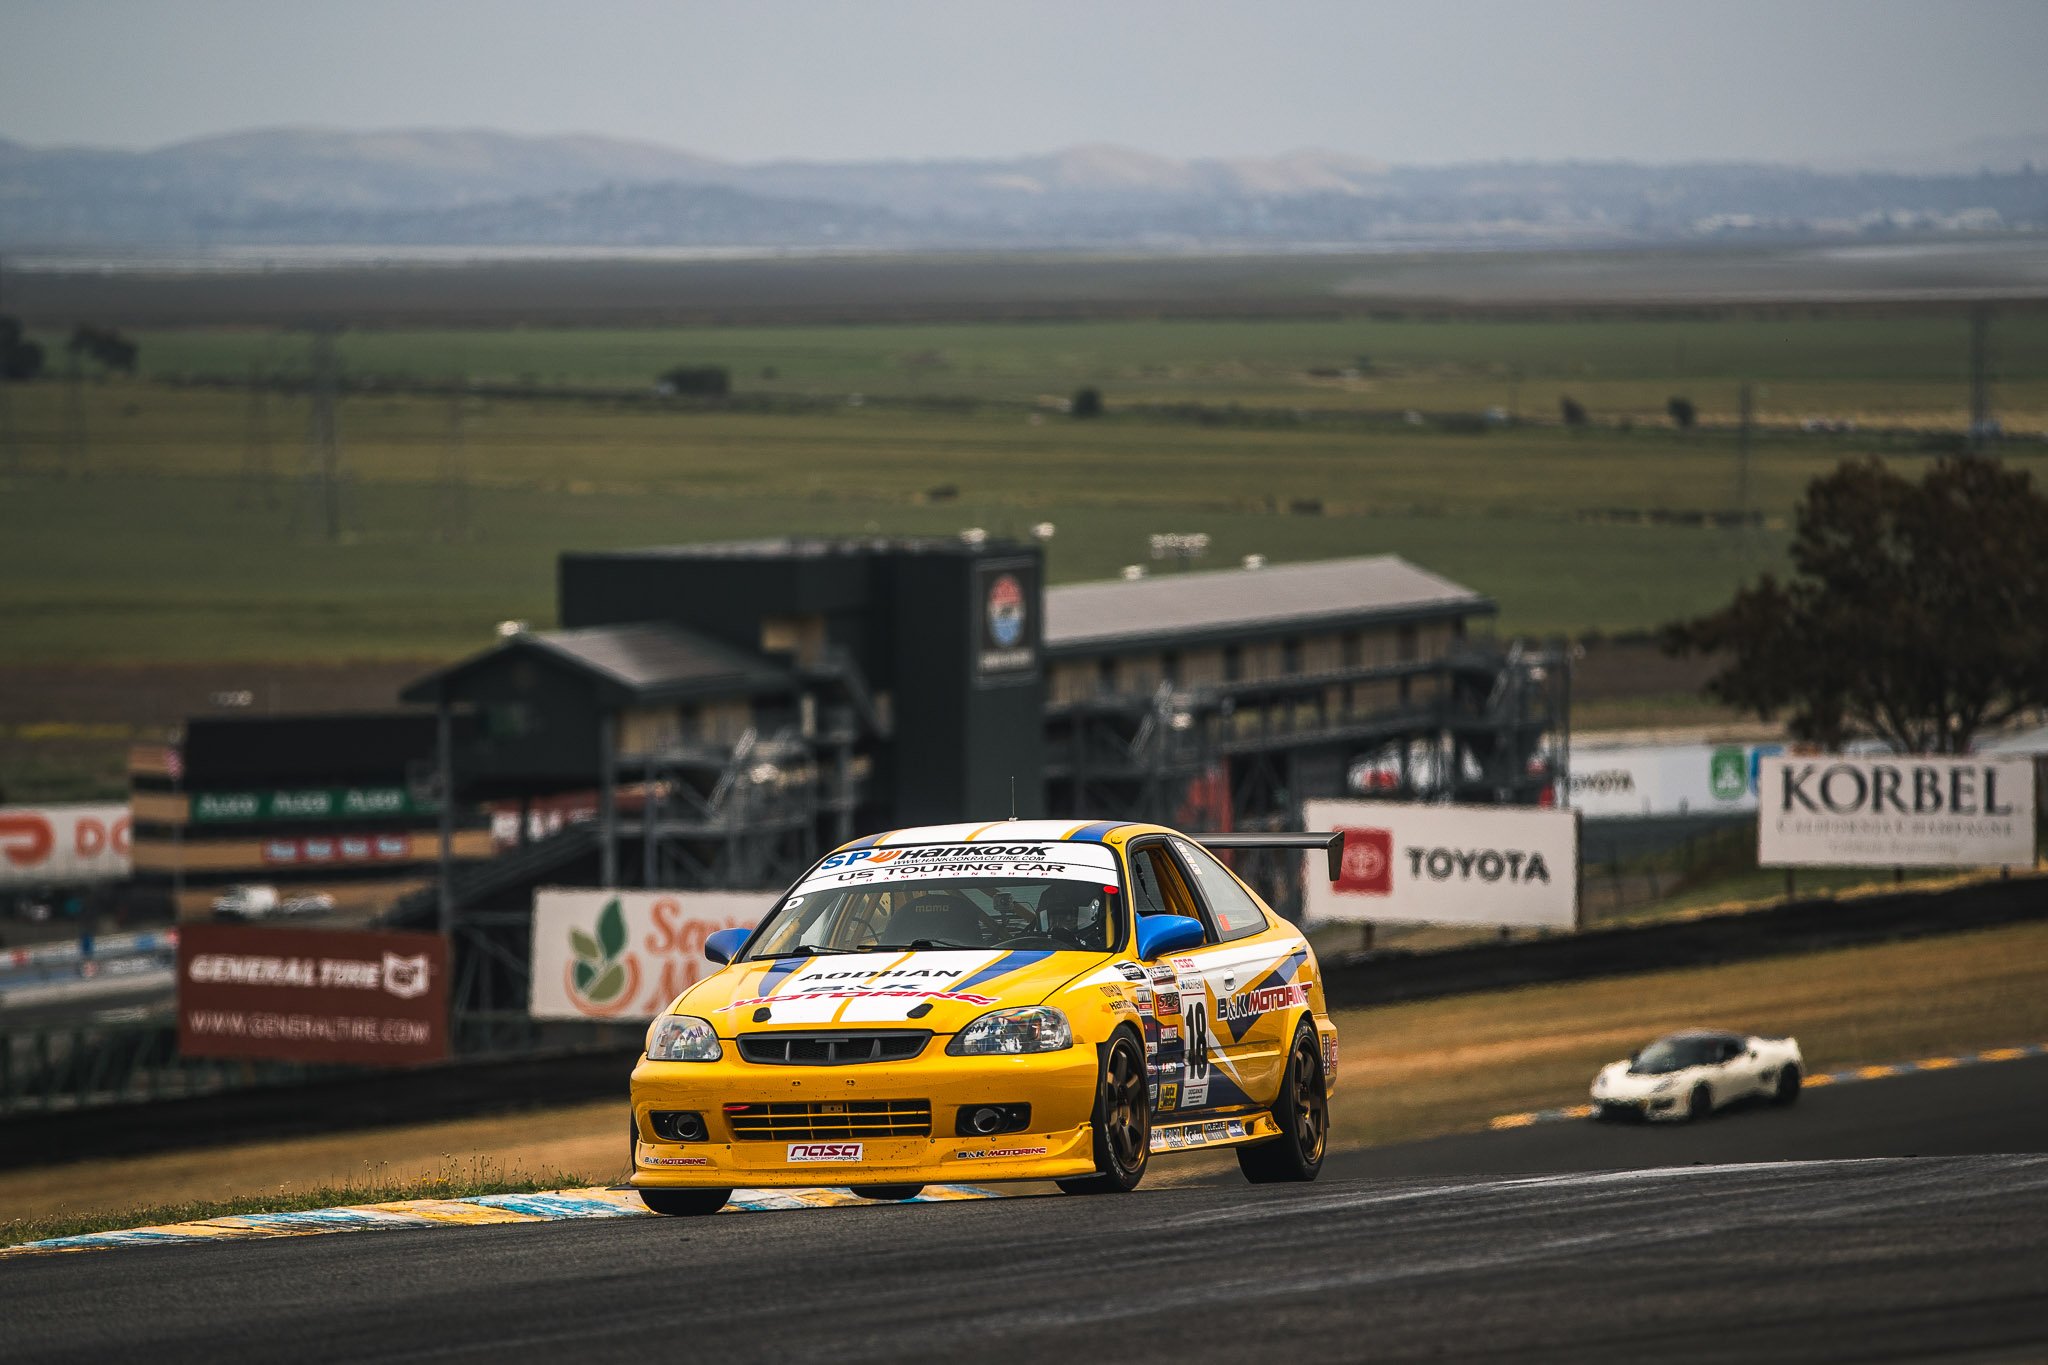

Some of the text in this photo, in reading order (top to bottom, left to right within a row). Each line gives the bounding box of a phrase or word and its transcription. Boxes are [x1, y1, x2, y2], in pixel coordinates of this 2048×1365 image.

[1780, 762, 2014, 816] KORBEL
[821, 850, 872, 871] SP
[838, 863, 1066, 882] US TOURING CAR
[893, 855, 1048, 866] WWW.HANKOOKRACETIRE.COM
[1406, 845, 1550, 885] TOYOTA
[915, 903, 949, 913] momo
[187, 953, 316, 988] GENERAL
[319, 957, 381, 991] TIRE
[1217, 993, 1248, 1020] B&K
[1185, 1001, 1208, 1079] 18
[790, 1145, 861, 1157] nasa
